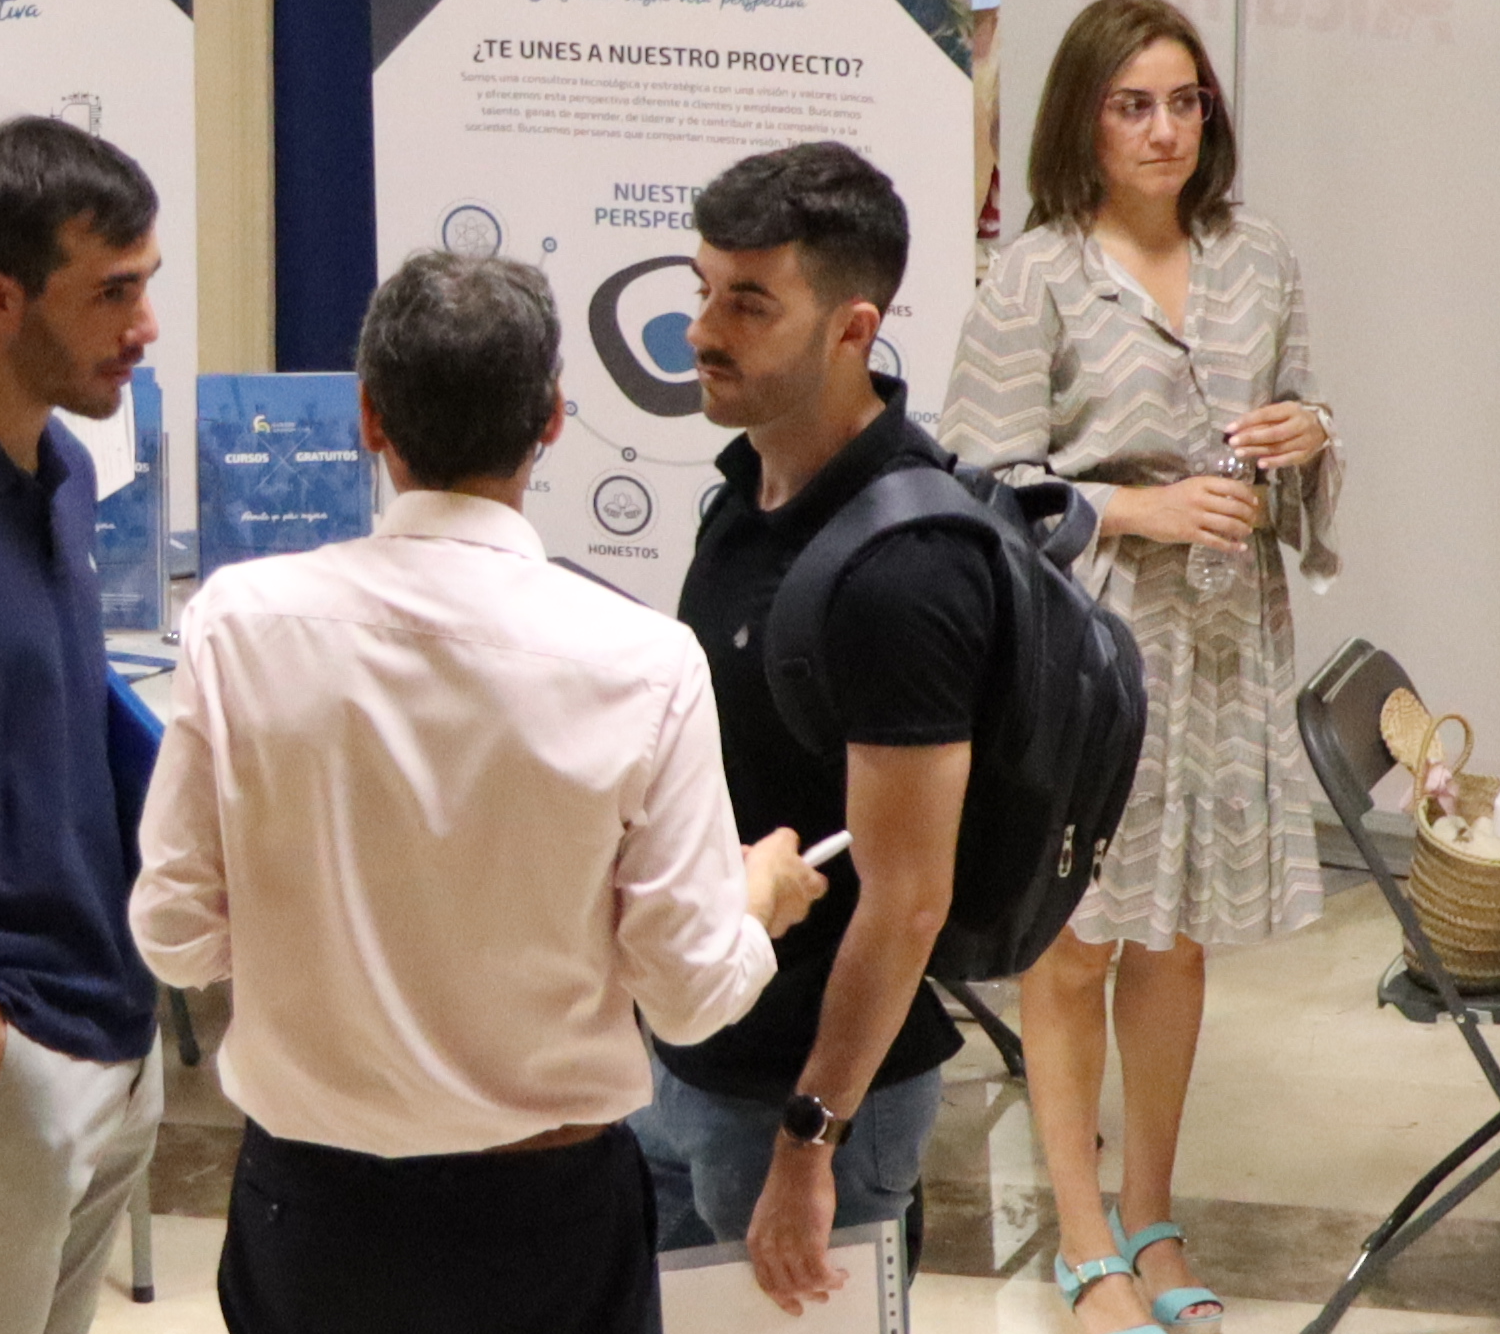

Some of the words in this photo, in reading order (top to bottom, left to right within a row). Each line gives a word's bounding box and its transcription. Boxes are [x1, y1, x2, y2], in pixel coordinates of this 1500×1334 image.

[473, 39, 513, 63] ¿TE
[520, 40, 582, 62] UNES
[587, 44, 603, 63] A
[609, 45, 720, 68] NUESTRO
[727, 51, 864, 78] PROYECTO?
[614, 182, 703, 204] NUESTR
[595, 207, 694, 230] PERSPEC
[225, 453, 269, 464] CURSOS
[296, 450, 358, 462] GRATUITOS
[587, 543, 660, 559] HONESTOS
